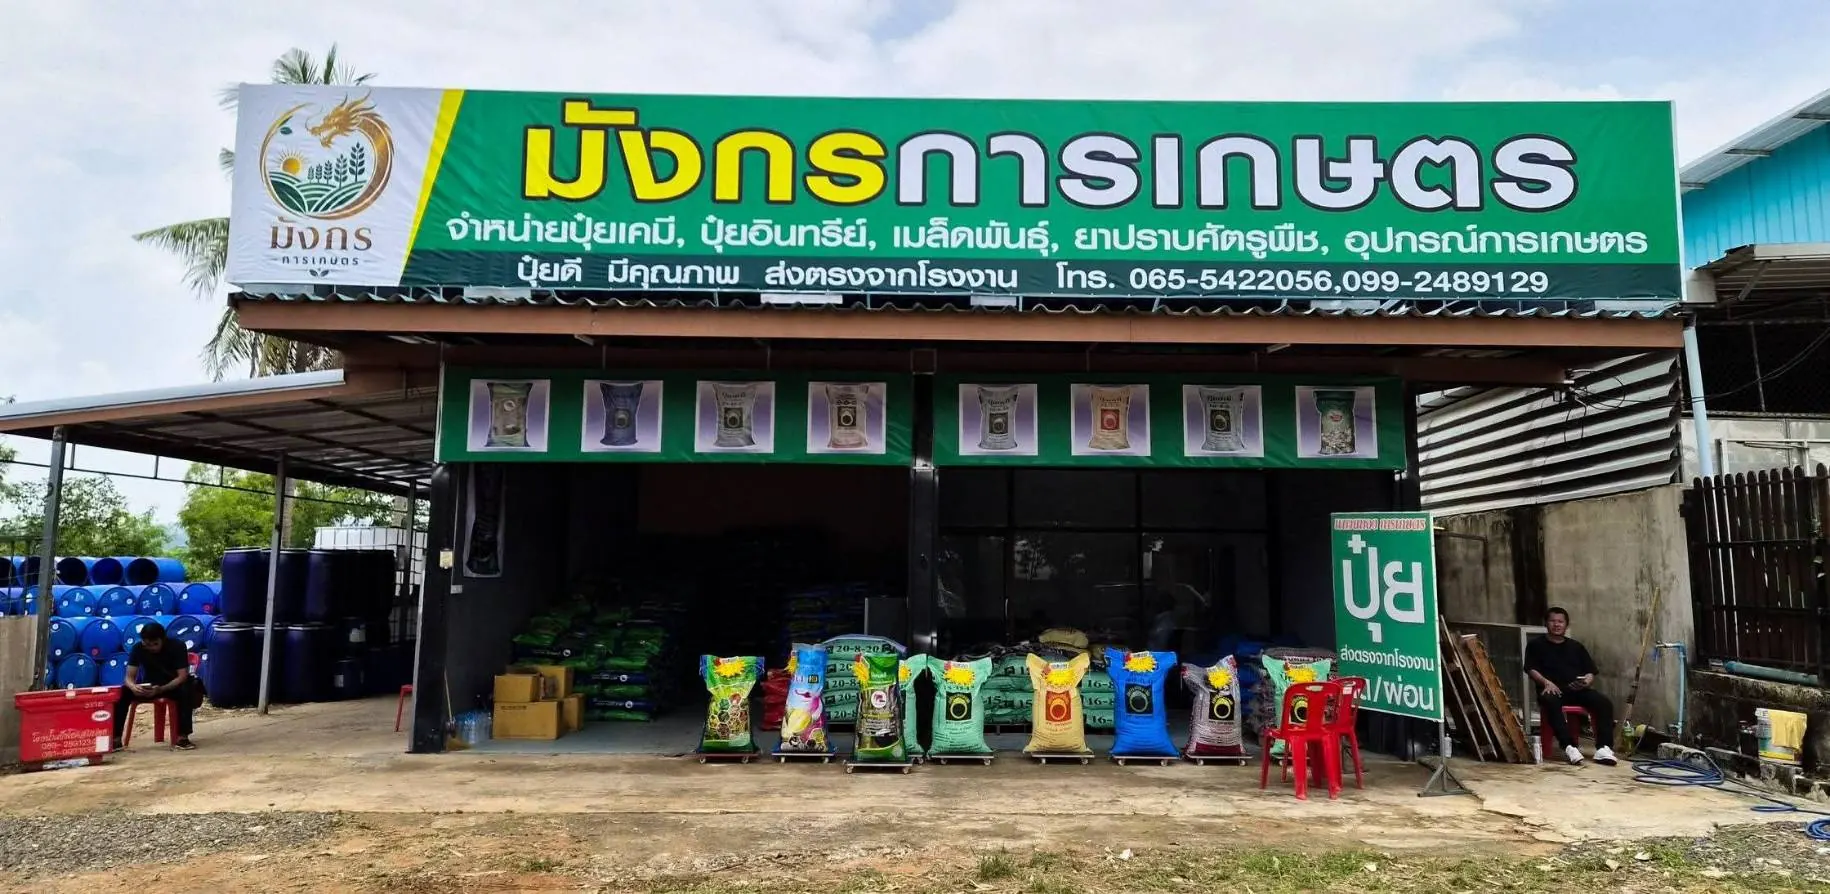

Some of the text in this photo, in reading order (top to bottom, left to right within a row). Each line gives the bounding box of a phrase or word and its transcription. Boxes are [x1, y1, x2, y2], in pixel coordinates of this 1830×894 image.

[522, 98, 1578, 213] มังกรการเกษตร
[270, 216, 373, 251] มังกร
[446, 212, 1649, 260] จำหน่ายปุ๋ยเคมี, ปุ๋ยอินทรีย์, เมล็ดพันธุ์, ยาปราบศัตรูพืช, อุปกรณ์การเกษตร
[282, 255, 360, 266] การเกษตร
[518, 255, 1548, 294] ปุ๋ยดี มีคุณภาพ ส่งตรงจากโรงงาน โทร. 065-5422056,099-2489129
[1342, 534, 1425, 643] ปุ๋ย
[835, 645, 880, 654] 20-8-20
[1340, 644, 1435, 672] ส่งตรงจากโรงงาน
[1343, 675, 1435, 712] ด/ผ่อน
